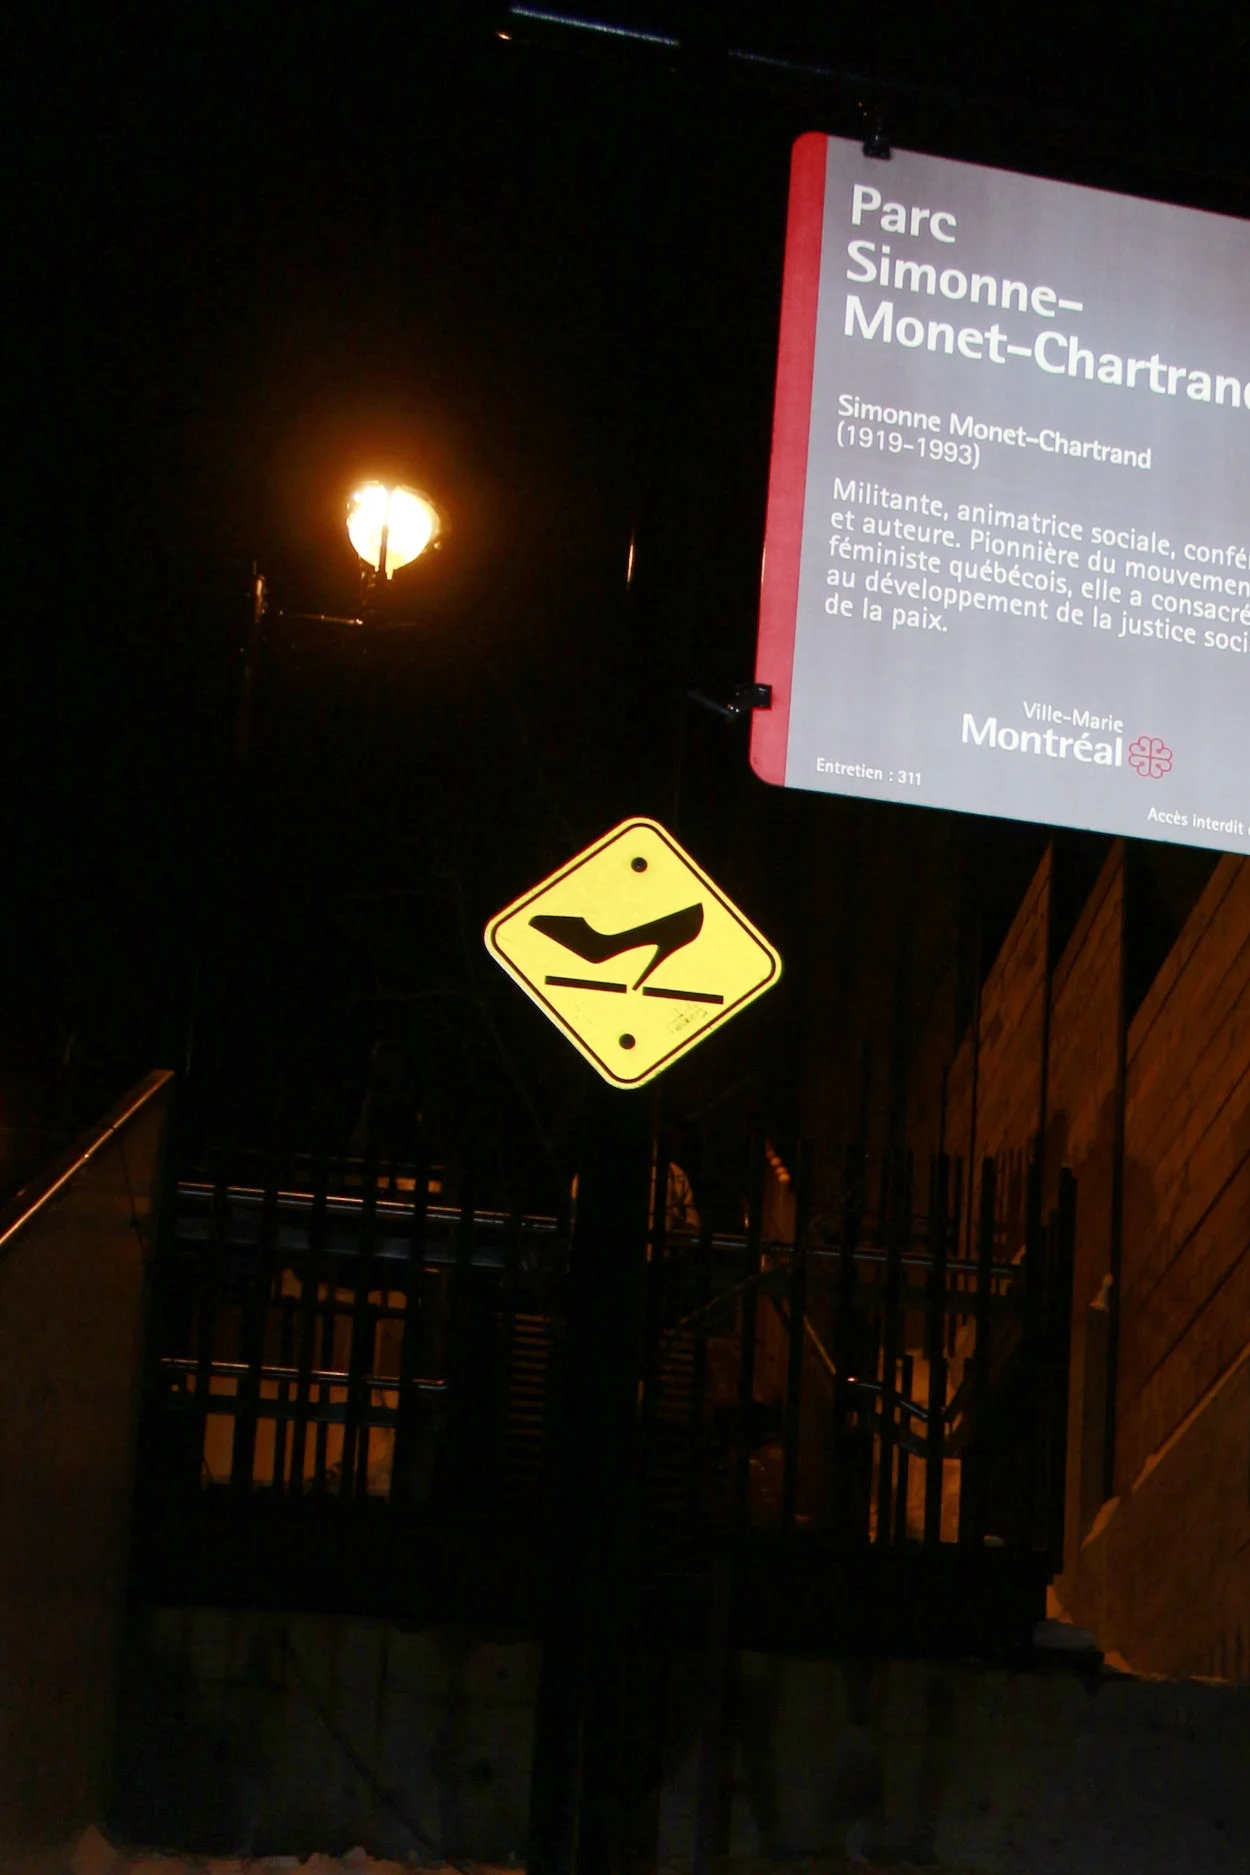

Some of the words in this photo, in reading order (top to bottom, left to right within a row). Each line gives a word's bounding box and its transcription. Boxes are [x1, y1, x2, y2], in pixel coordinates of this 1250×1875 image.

[851, 183, 957, 244] Parc
[846, 239, 1084, 318] Simonne-
[836, 419, 980, 470] (1919-1993)
[837, 393, 942, 433] Simonne
[949, 412, 1152, 470] Monet-Chartrand
[830, 510, 855, 532] et
[862, 516, 961, 549] auteure.
[970, 528, 1080, 569] Pionnière
[1087, 549, 1116, 574] du
[833, 477, 949, 521] Militante,
[956, 503, 1083, 541] animatrice
[1091, 526, 1176, 561] sociale,
[828, 534, 941, 574] féministe
[949, 558, 1073, 599] québécois,
[1081, 577, 1122, 604] elle
[1129, 589, 1143, 607] a
[824, 592, 854, 618] de
[862, 596, 883, 622] la
[892, 606, 948, 632] paix.
[826, 568, 856, 589] au
[864, 569, 1049, 620] développement
[1056, 600, 1084, 626] de
[1092, 605, 1112, 630] la
[1117, 610, 1197, 645] justice
[961, 713, 1123, 767] Montréal
[1022, 700, 1124, 734] Ville-Marie
[816, 757, 883, 781] Entretien
[897, 769, 921, 786] 311
[1147, 806, 1189, 826] Accès
[1192, 813, 1244, 836] interdit
